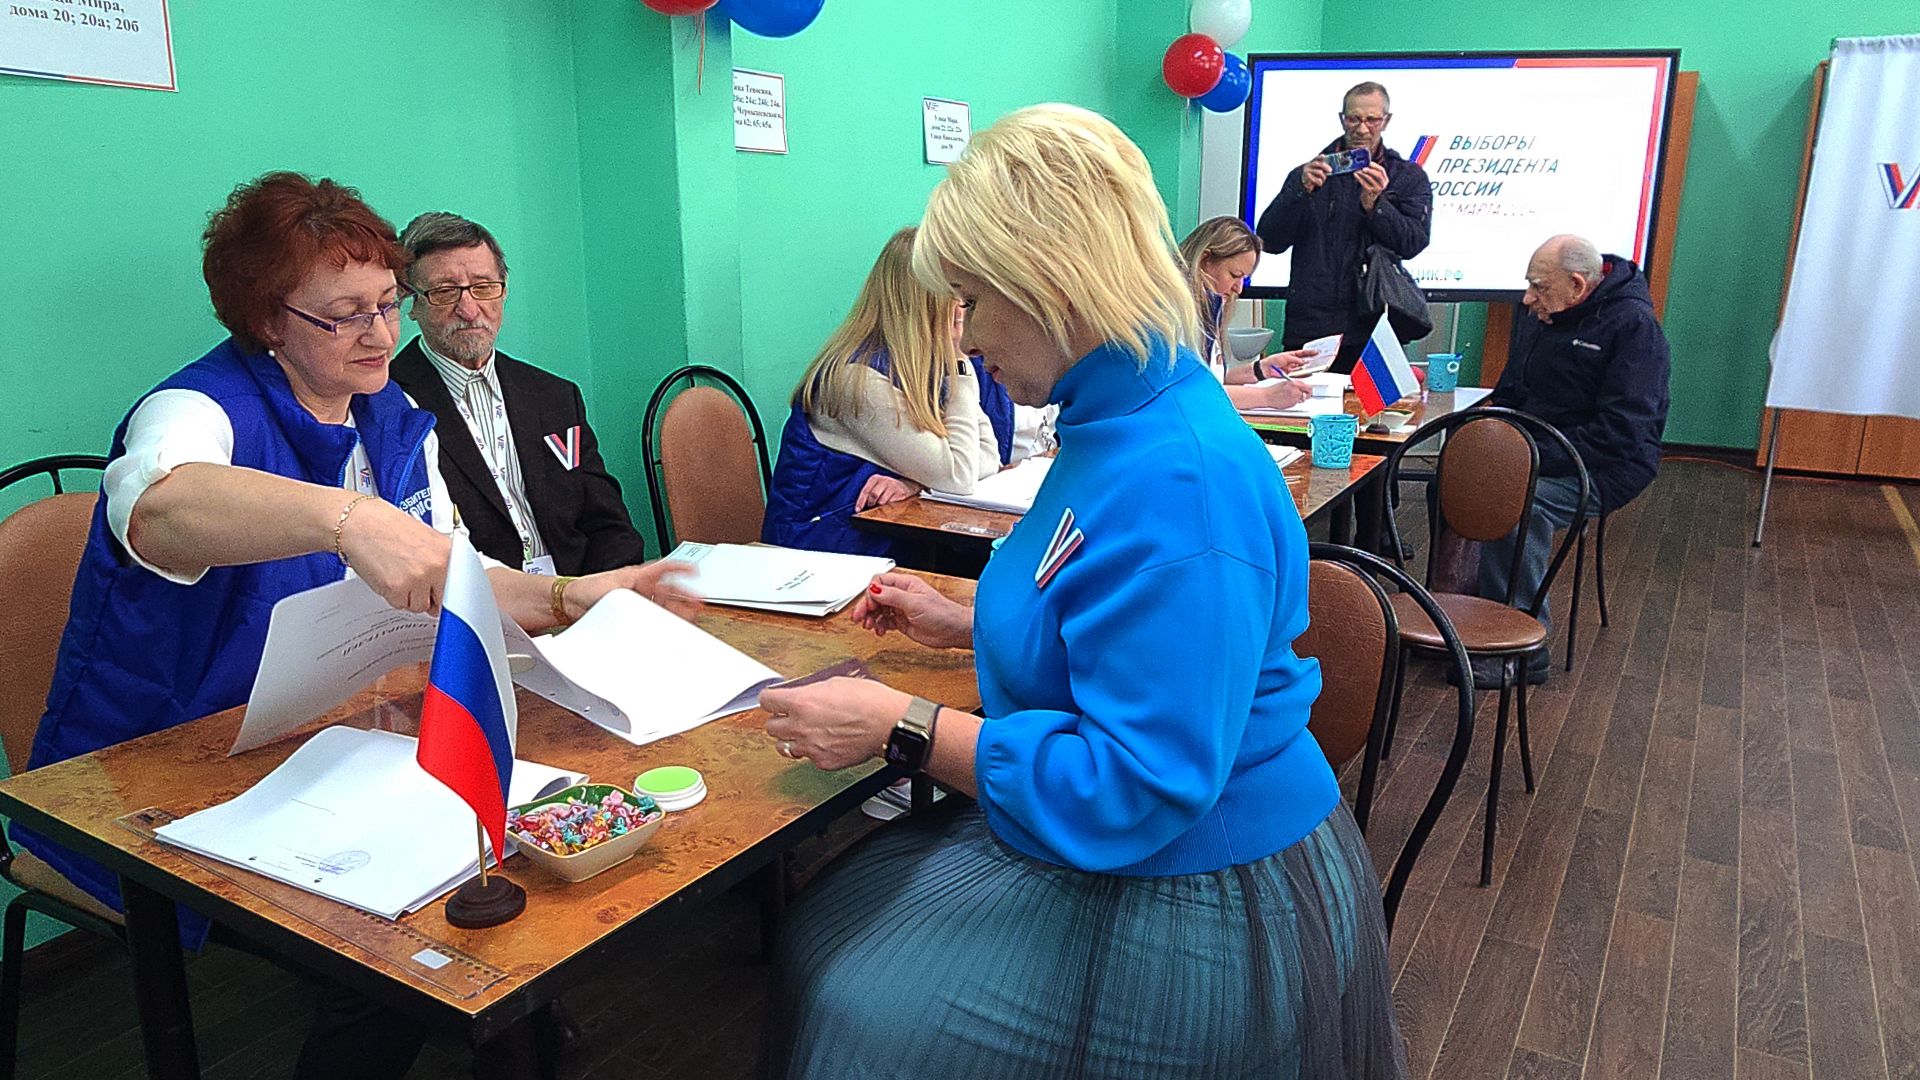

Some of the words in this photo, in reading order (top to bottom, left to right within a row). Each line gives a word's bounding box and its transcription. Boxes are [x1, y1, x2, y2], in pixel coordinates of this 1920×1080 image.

[9, 4, 49, 20] дома
[53, 8, 76, 25] 20;
[80, 13, 111, 31] 20а;
[115, 17, 139, 32] 20б
[1449, 135, 1536, 151] ВЫБОРЫ
[1437, 158, 1559, 176] ПРЕЗИДЕНТА
[1430, 181, 1504, 197] РОССИИ
